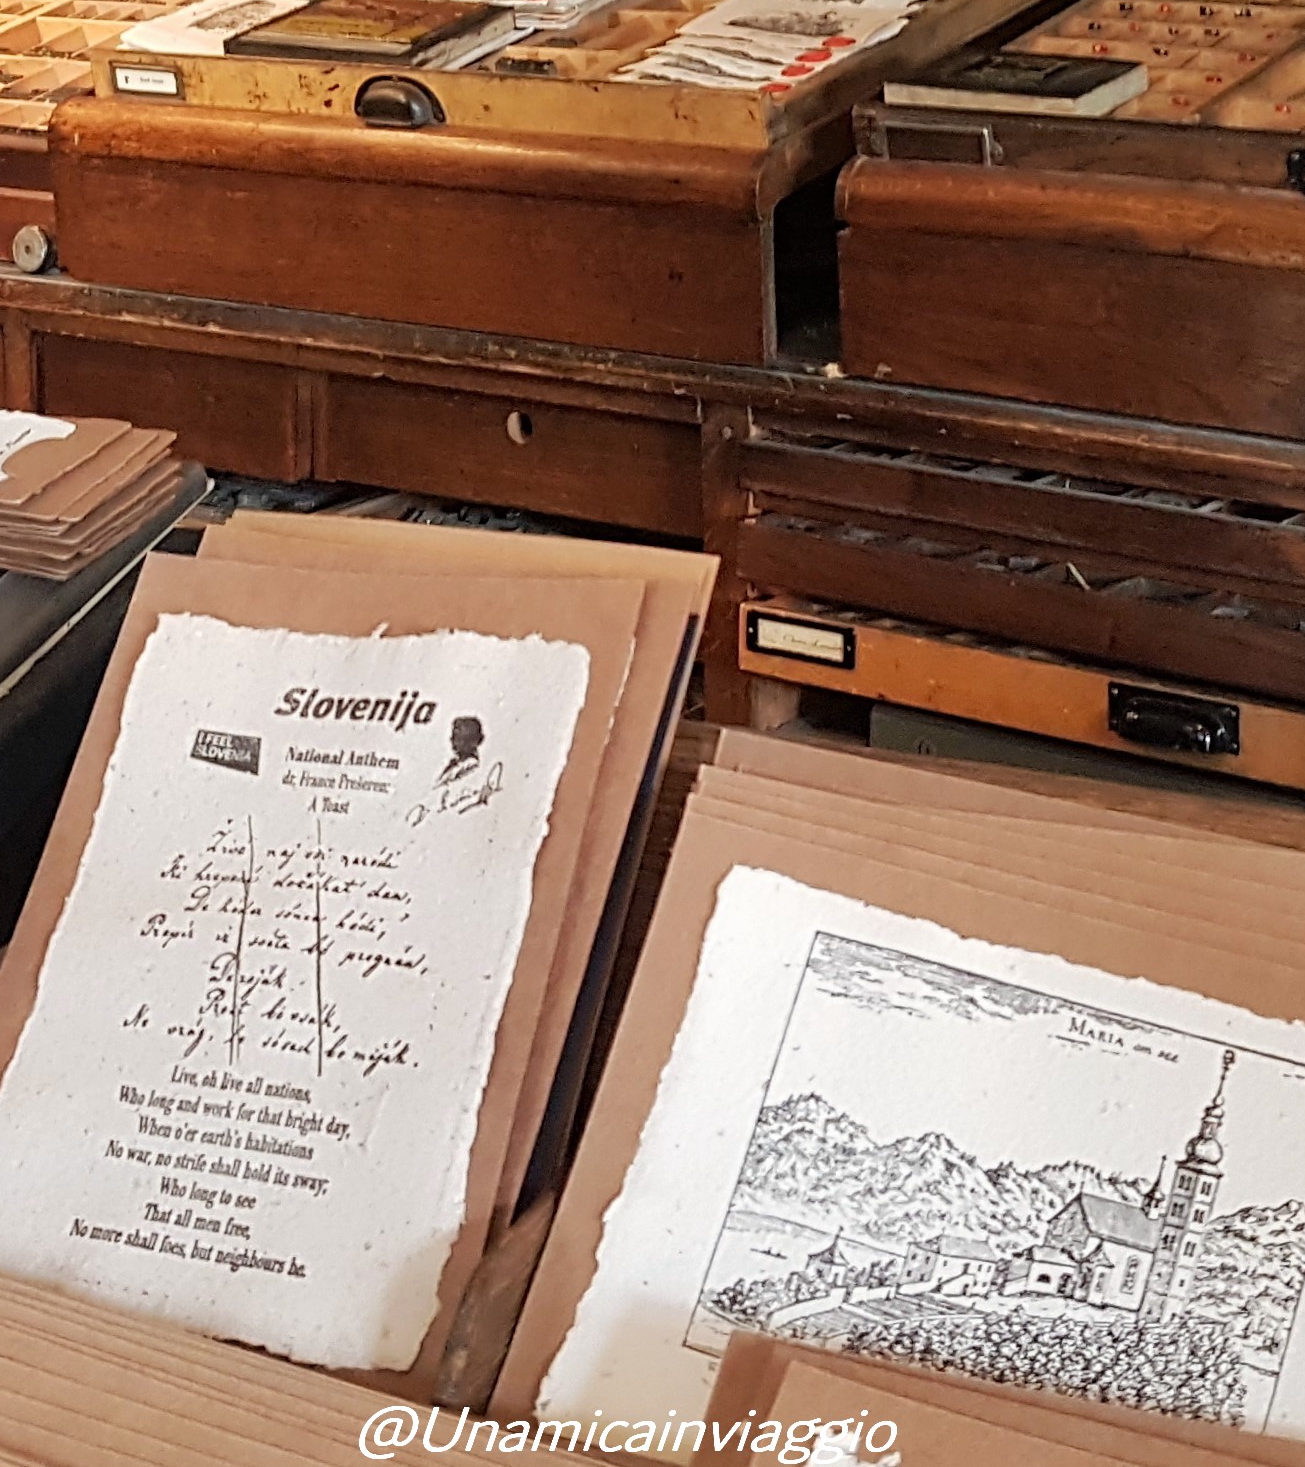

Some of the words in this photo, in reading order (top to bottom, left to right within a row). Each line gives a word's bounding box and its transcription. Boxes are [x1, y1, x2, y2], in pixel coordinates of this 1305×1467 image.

[274, 687, 438, 731] Slovenija
[206, 734, 233, 748] FEEL
[285, 746, 342, 766] National
[346, 750, 400, 770] Anthem
[300, 771, 336, 788] France
[1069, 1017, 1124, 1047] MARIA
[202, 1070, 217, 1085] oh
[220, 1071, 242, 1092] live
[246, 1077, 265, 1094] all
[119, 1085, 145, 1106] Who
[148, 1090, 174, 1115] long
[177, 1096, 200, 1114] and
[203, 1100, 234, 1119] work
[236, 1103, 254, 1121] for
[257, 1106, 283, 1126] that
[285, 1110, 324, 1136] bright
[138, 1115, 172, 1140] When
[245, 1132, 314, 1160] habitations
[104, 1139, 124, 1159] No
[155, 1152, 172, 1167] no
[174, 1153, 207, 1173] strife
[209, 1156, 242, 1178] shall
[244, 1162, 272, 1183] hold
[273, 1167, 291, 1186] its
[160, 1176, 186, 1198] Who
[189, 1181, 217, 1209] long
[220, 1188, 233, 1205] to
[235, 1193, 257, 1209] see
[143, 1203, 171, 1224] That
[174, 1209, 193, 1228] all
[196, 1217, 222, 1233] men
[69, 1218, 88, 1237] No
[90, 1226, 122, 1243] more
[124, 1230, 158, 1253] shall
[191, 1239, 214, 1261] but
[215, 1247, 285, 1273] neighbours
